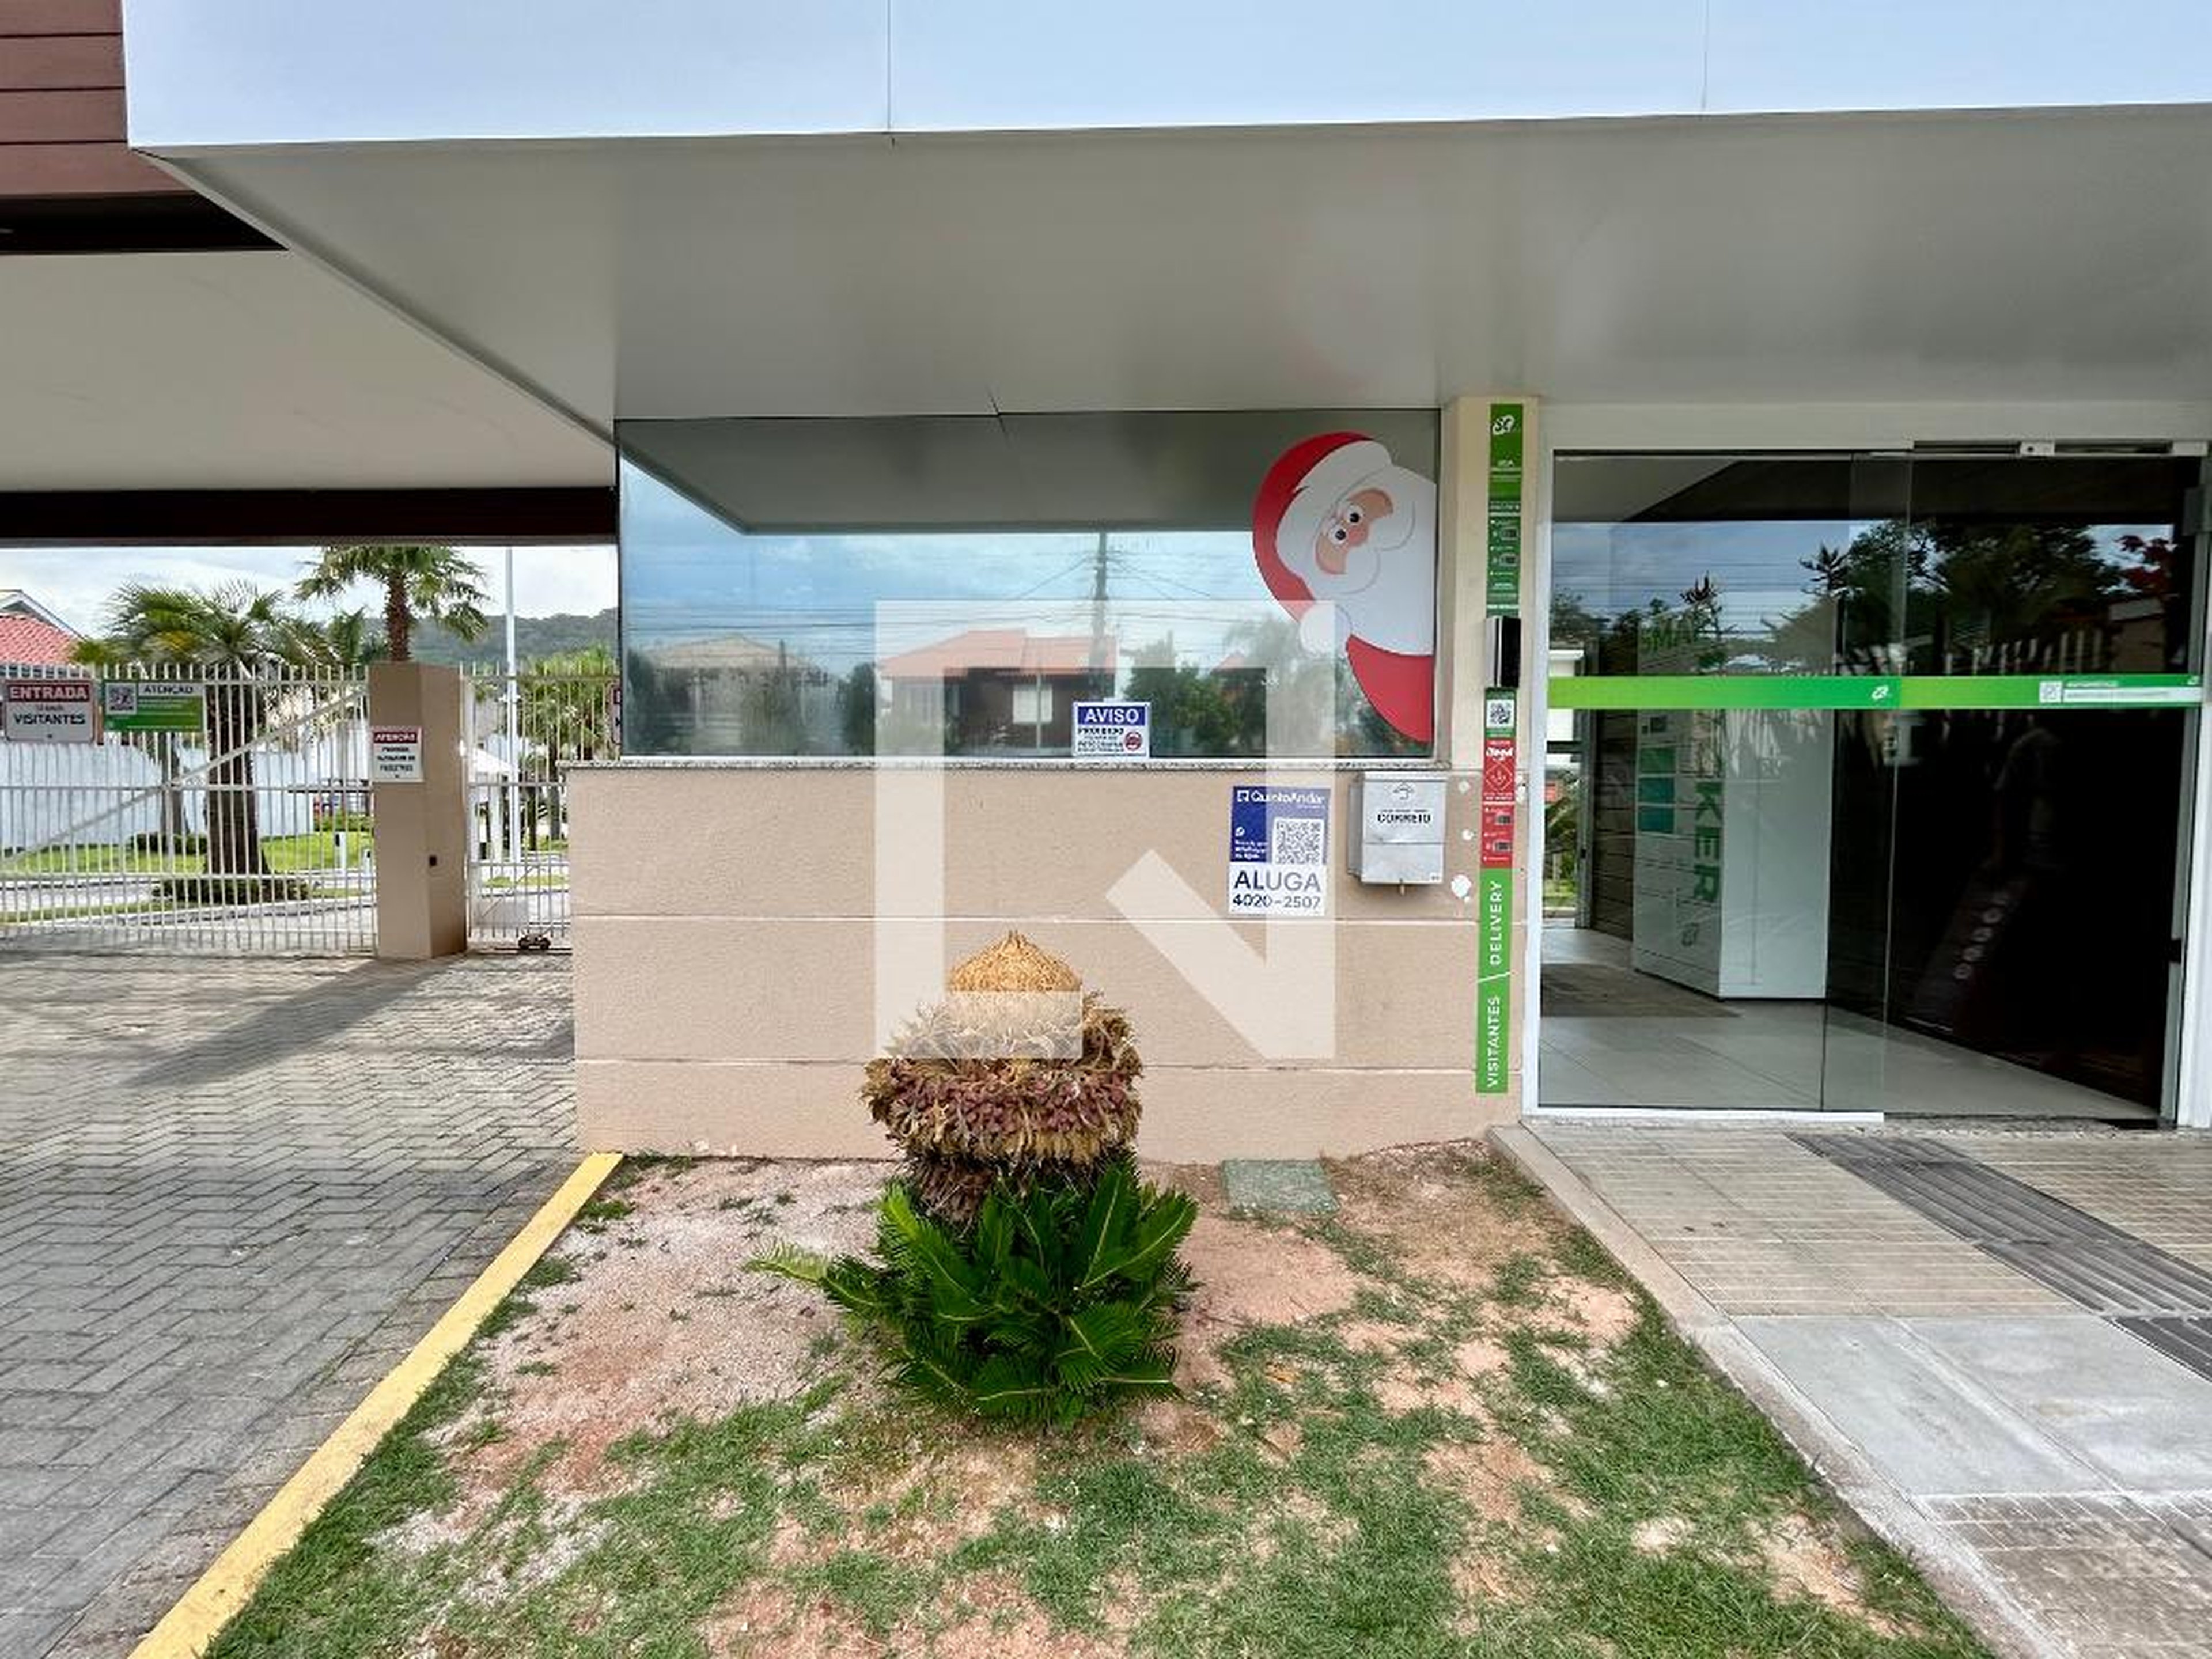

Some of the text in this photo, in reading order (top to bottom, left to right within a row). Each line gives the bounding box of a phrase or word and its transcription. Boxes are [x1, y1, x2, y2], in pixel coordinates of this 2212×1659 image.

[10, 687, 88, 699] ENTRADA
[14, 714, 85, 725] VISITANTES
[1085, 708, 1139, 723] AVISO
[1234, 870, 1321, 892] ALUGA
[1233, 894, 1321, 910] 4020-2507
[1490, 880, 1503, 966] DELIVERY
[1487, 997, 1501, 1088] VISITANTES
